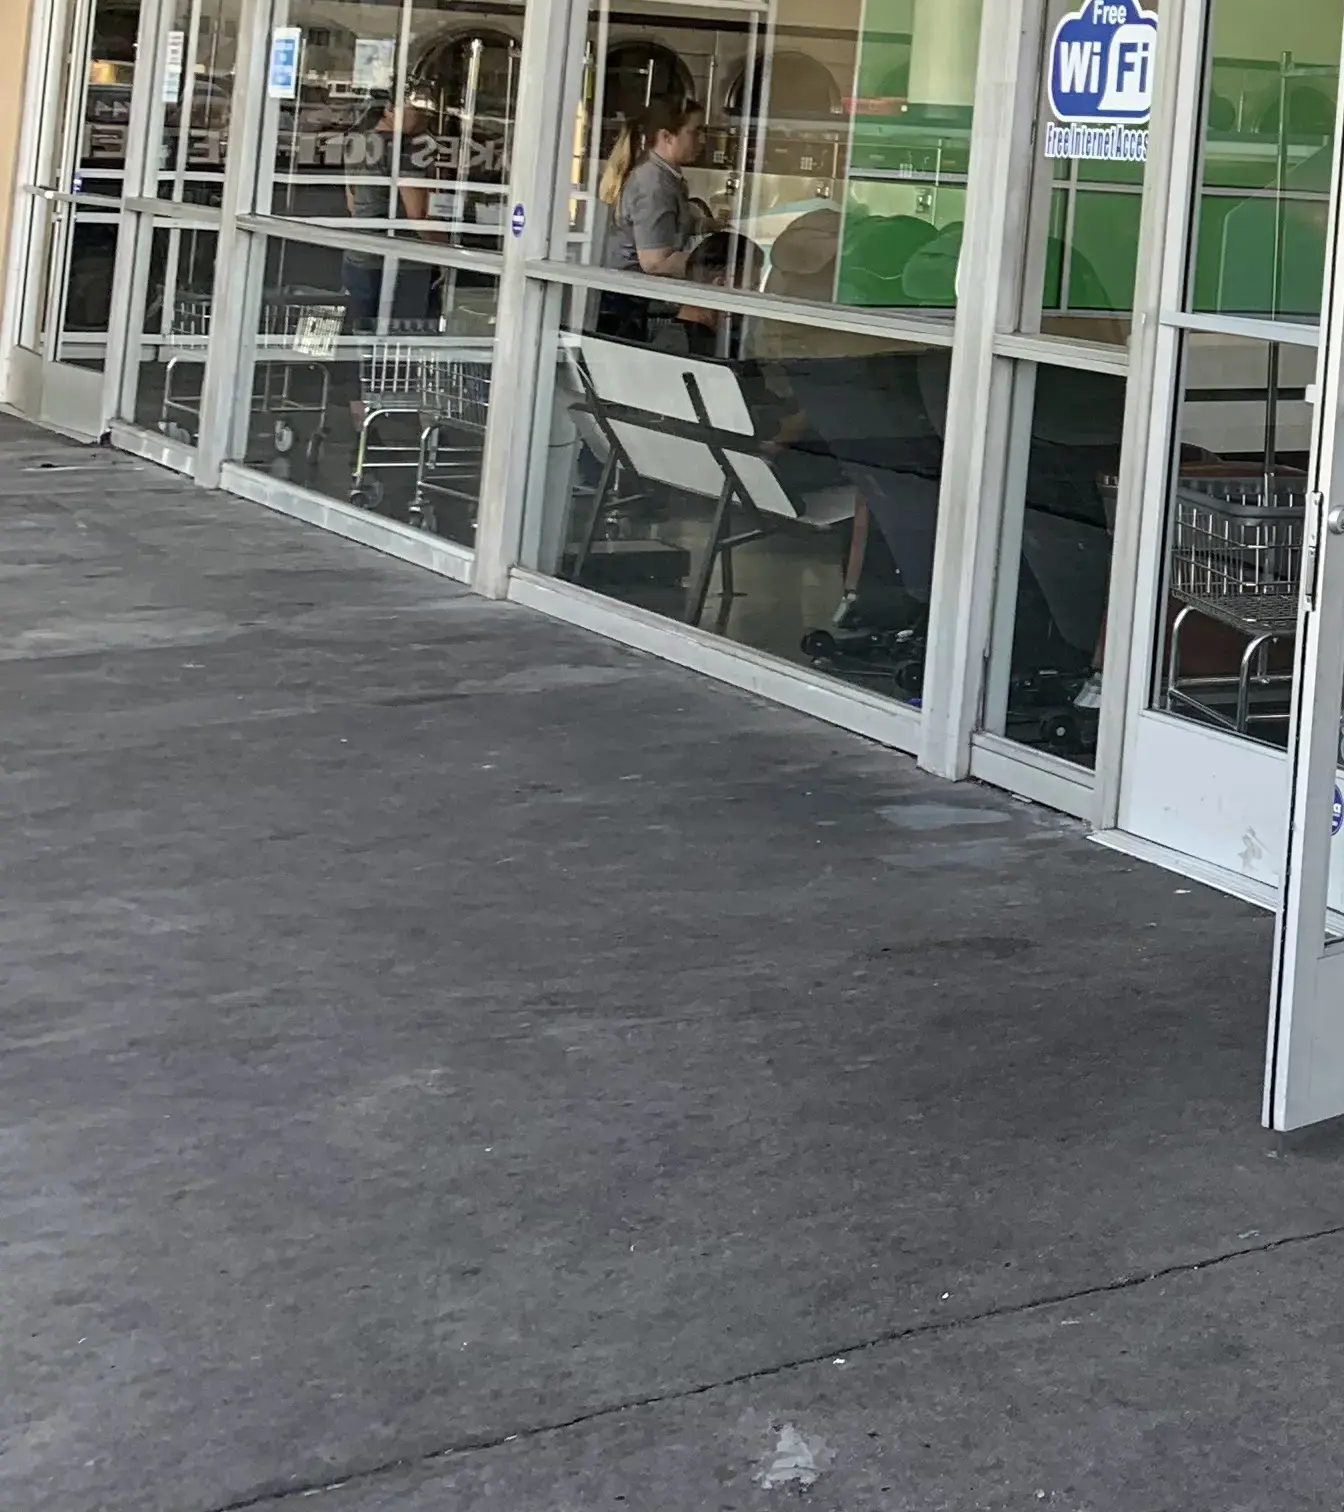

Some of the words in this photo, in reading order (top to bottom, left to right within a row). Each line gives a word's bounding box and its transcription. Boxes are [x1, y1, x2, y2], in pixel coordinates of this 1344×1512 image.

[1092, 0, 1128, 25] Free
[1044, 123, 1071, 157] Free
[1071, 125, 1115, 160] Internet
